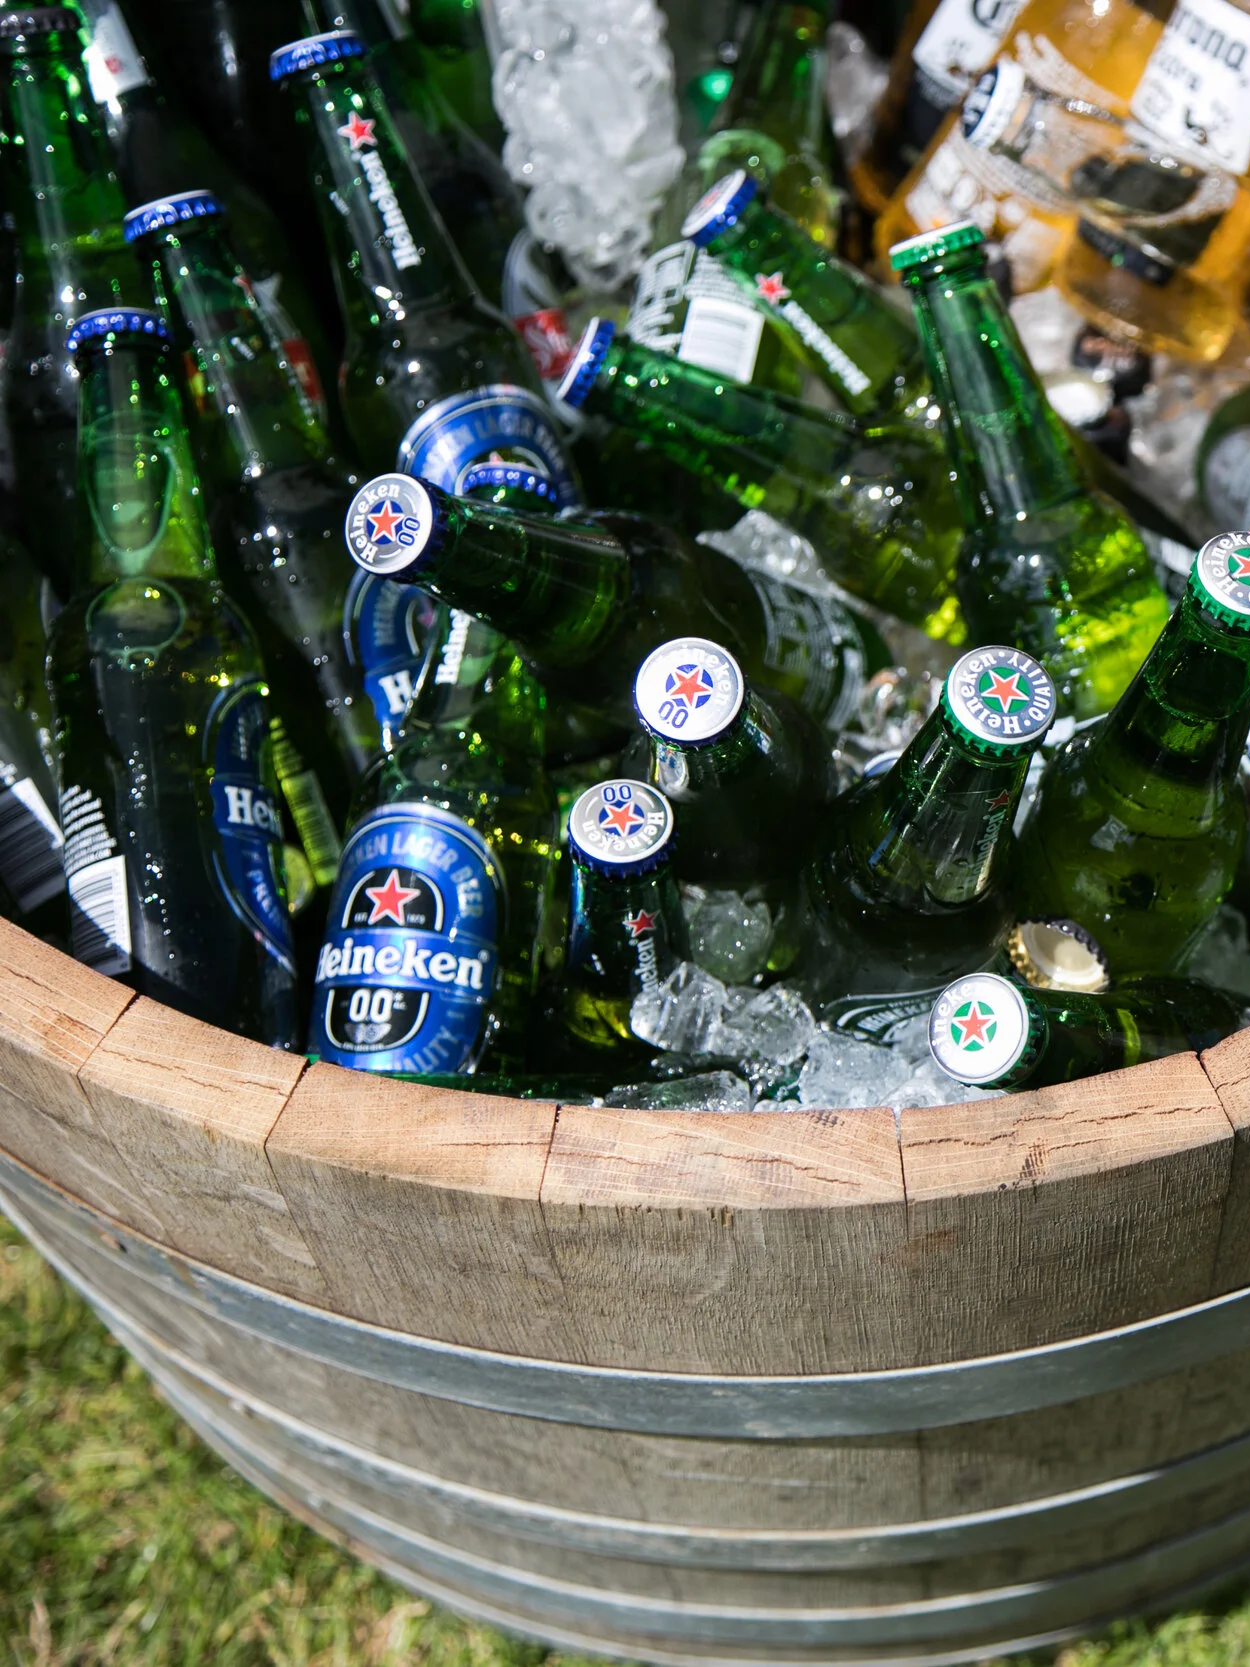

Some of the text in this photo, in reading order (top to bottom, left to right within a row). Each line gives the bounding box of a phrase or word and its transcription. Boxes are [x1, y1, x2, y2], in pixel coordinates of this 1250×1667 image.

[350, 483, 400, 563] Heineken
[961, 652, 1022, 734] Heineken
[1008, 652, 1052, 721] QUALITY
[391, 831, 458, 871] LAGER
[581, 811, 665, 852] Heineken
